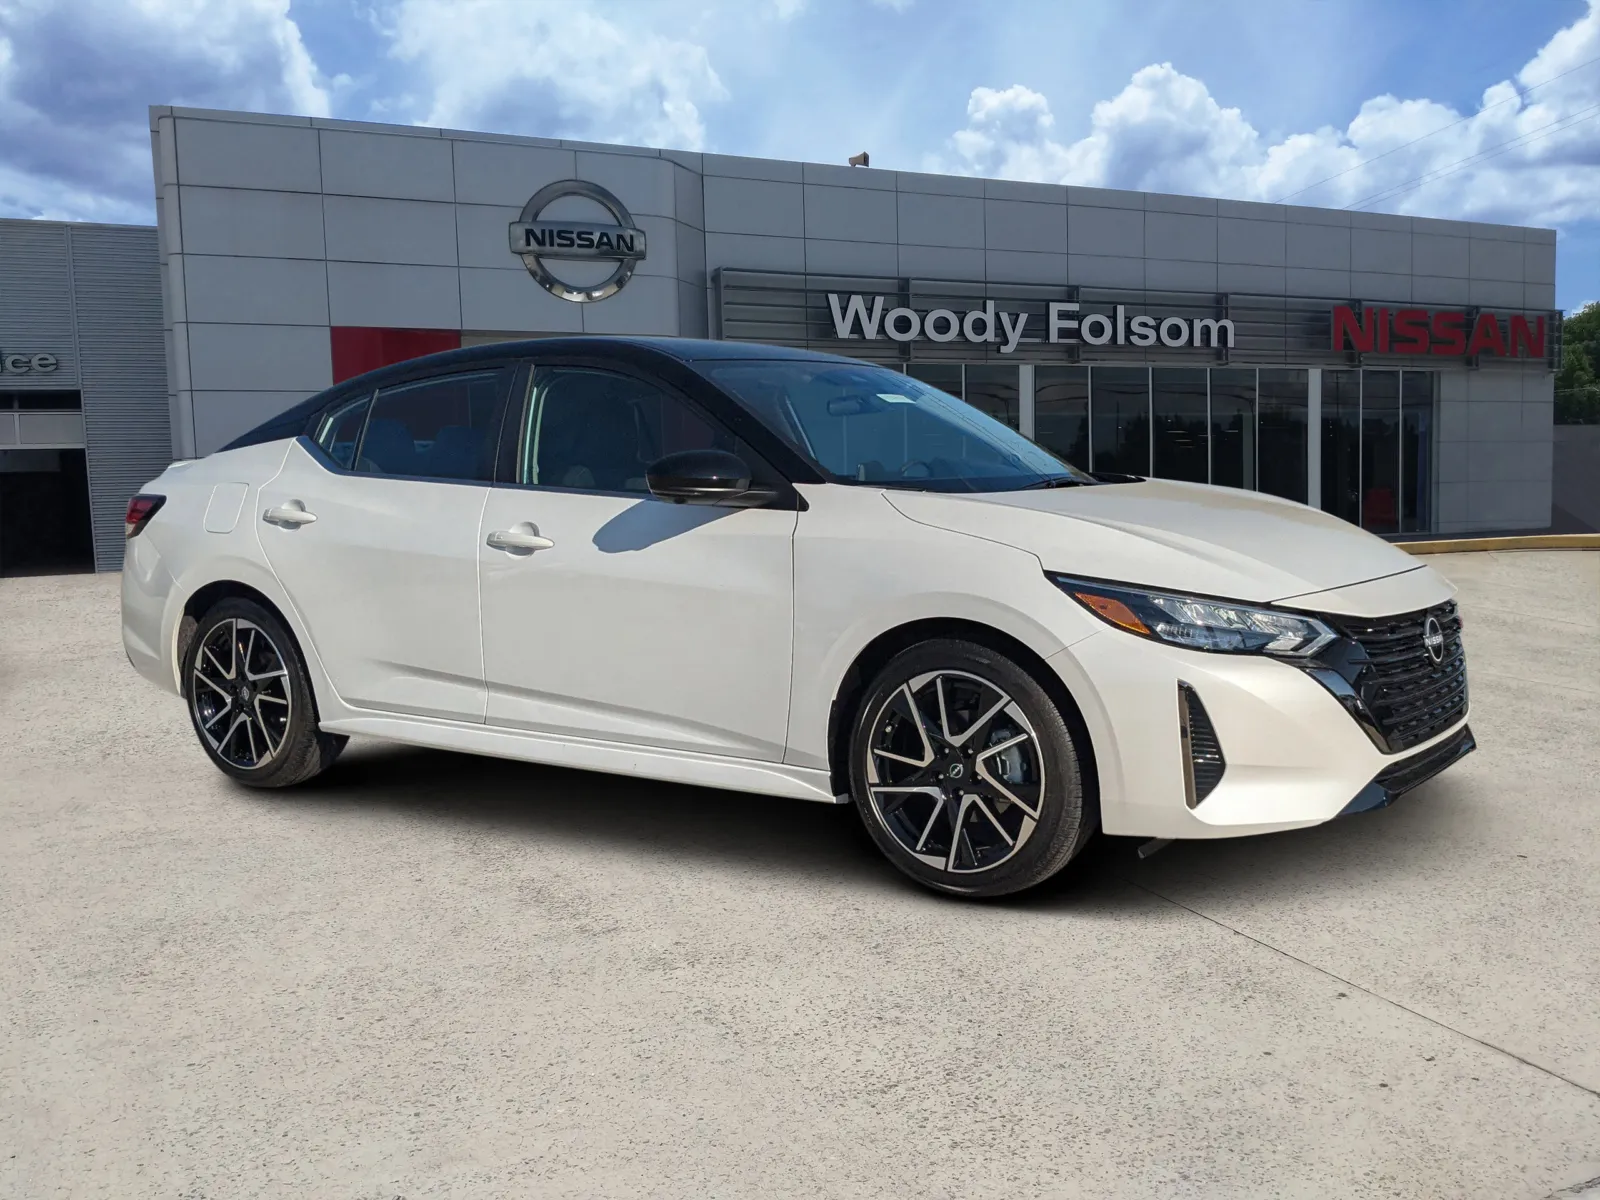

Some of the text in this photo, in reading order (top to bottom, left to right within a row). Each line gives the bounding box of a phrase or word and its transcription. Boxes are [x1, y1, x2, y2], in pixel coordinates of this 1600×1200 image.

[524, 228, 635, 252] NISSAN
[827, 293, 1235, 354] Woody Folsom
[1332, 305, 1545, 358] NISSAN
[0, 353, 57, 374] ce
